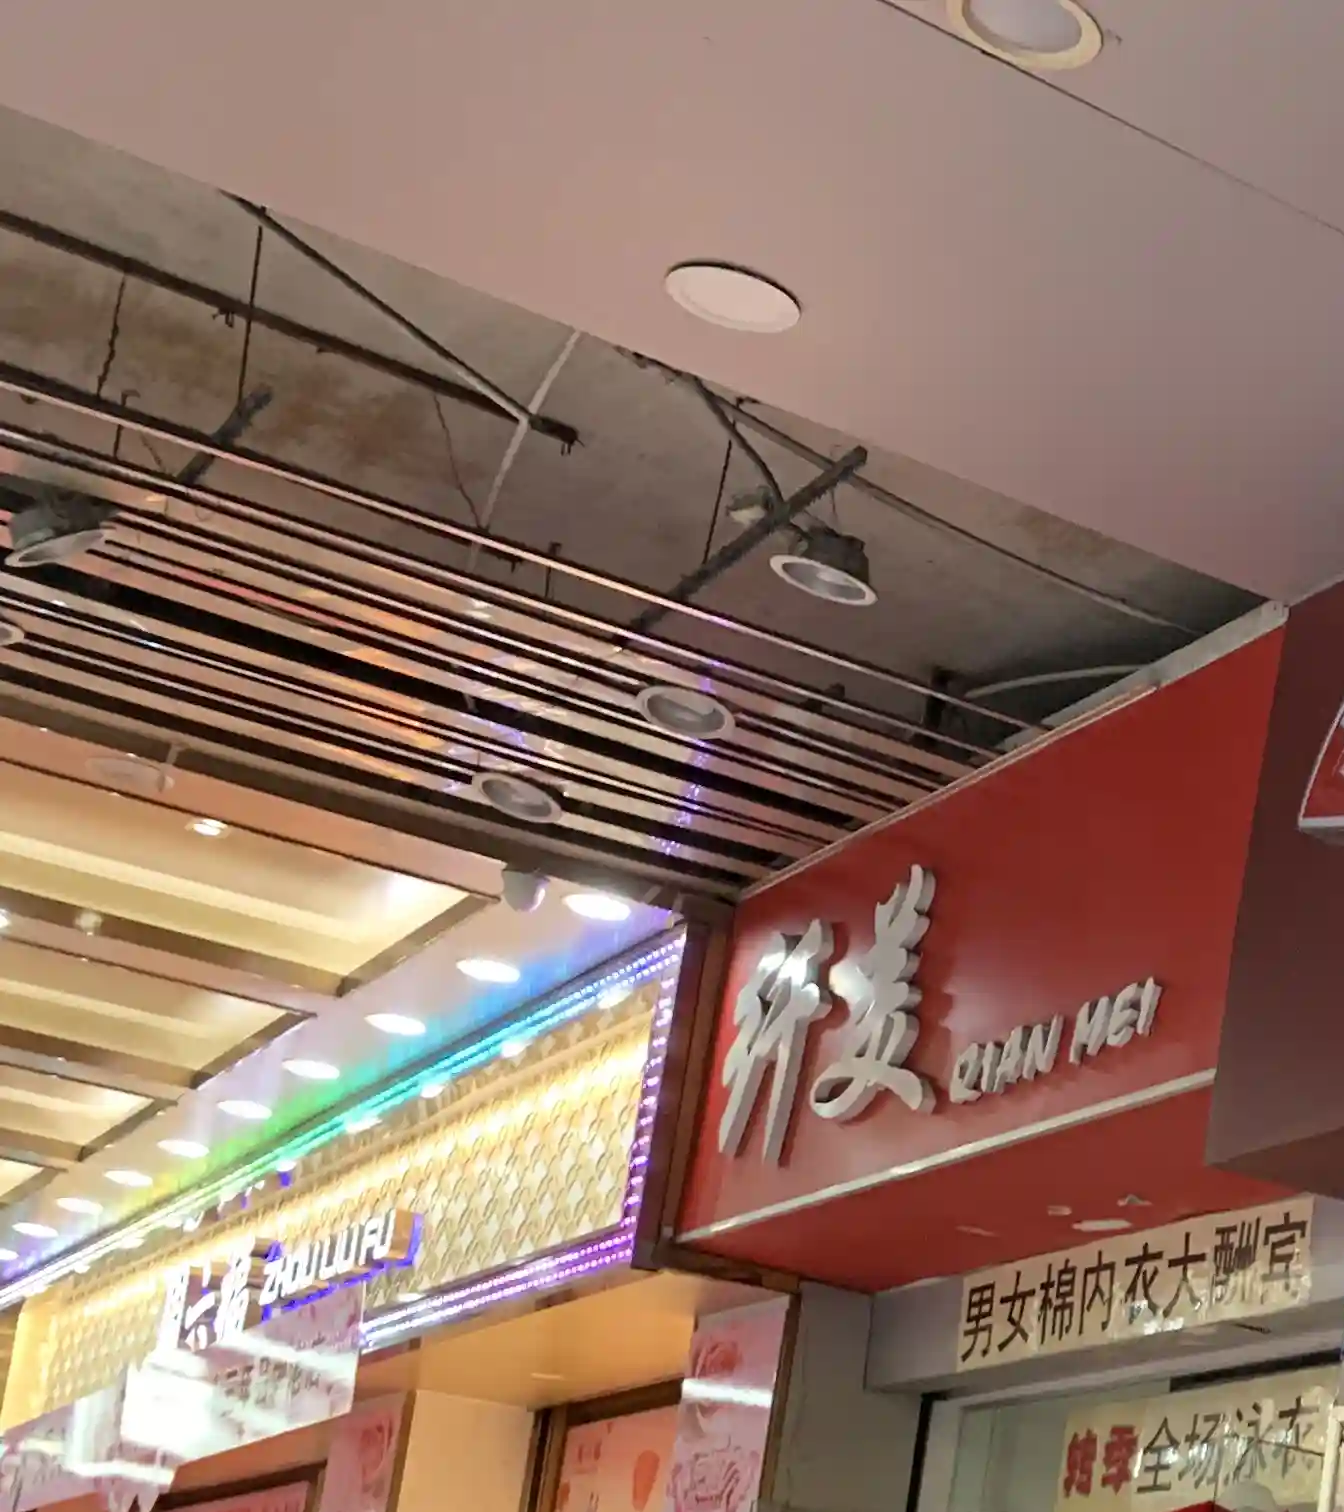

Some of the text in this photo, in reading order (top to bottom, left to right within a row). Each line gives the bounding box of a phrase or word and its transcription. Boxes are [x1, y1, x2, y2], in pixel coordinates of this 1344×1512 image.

[949, 976, 1162, 1104] QIAN MEI
[960, 1210, 1308, 1363] 男女棉内衣大酬宾
